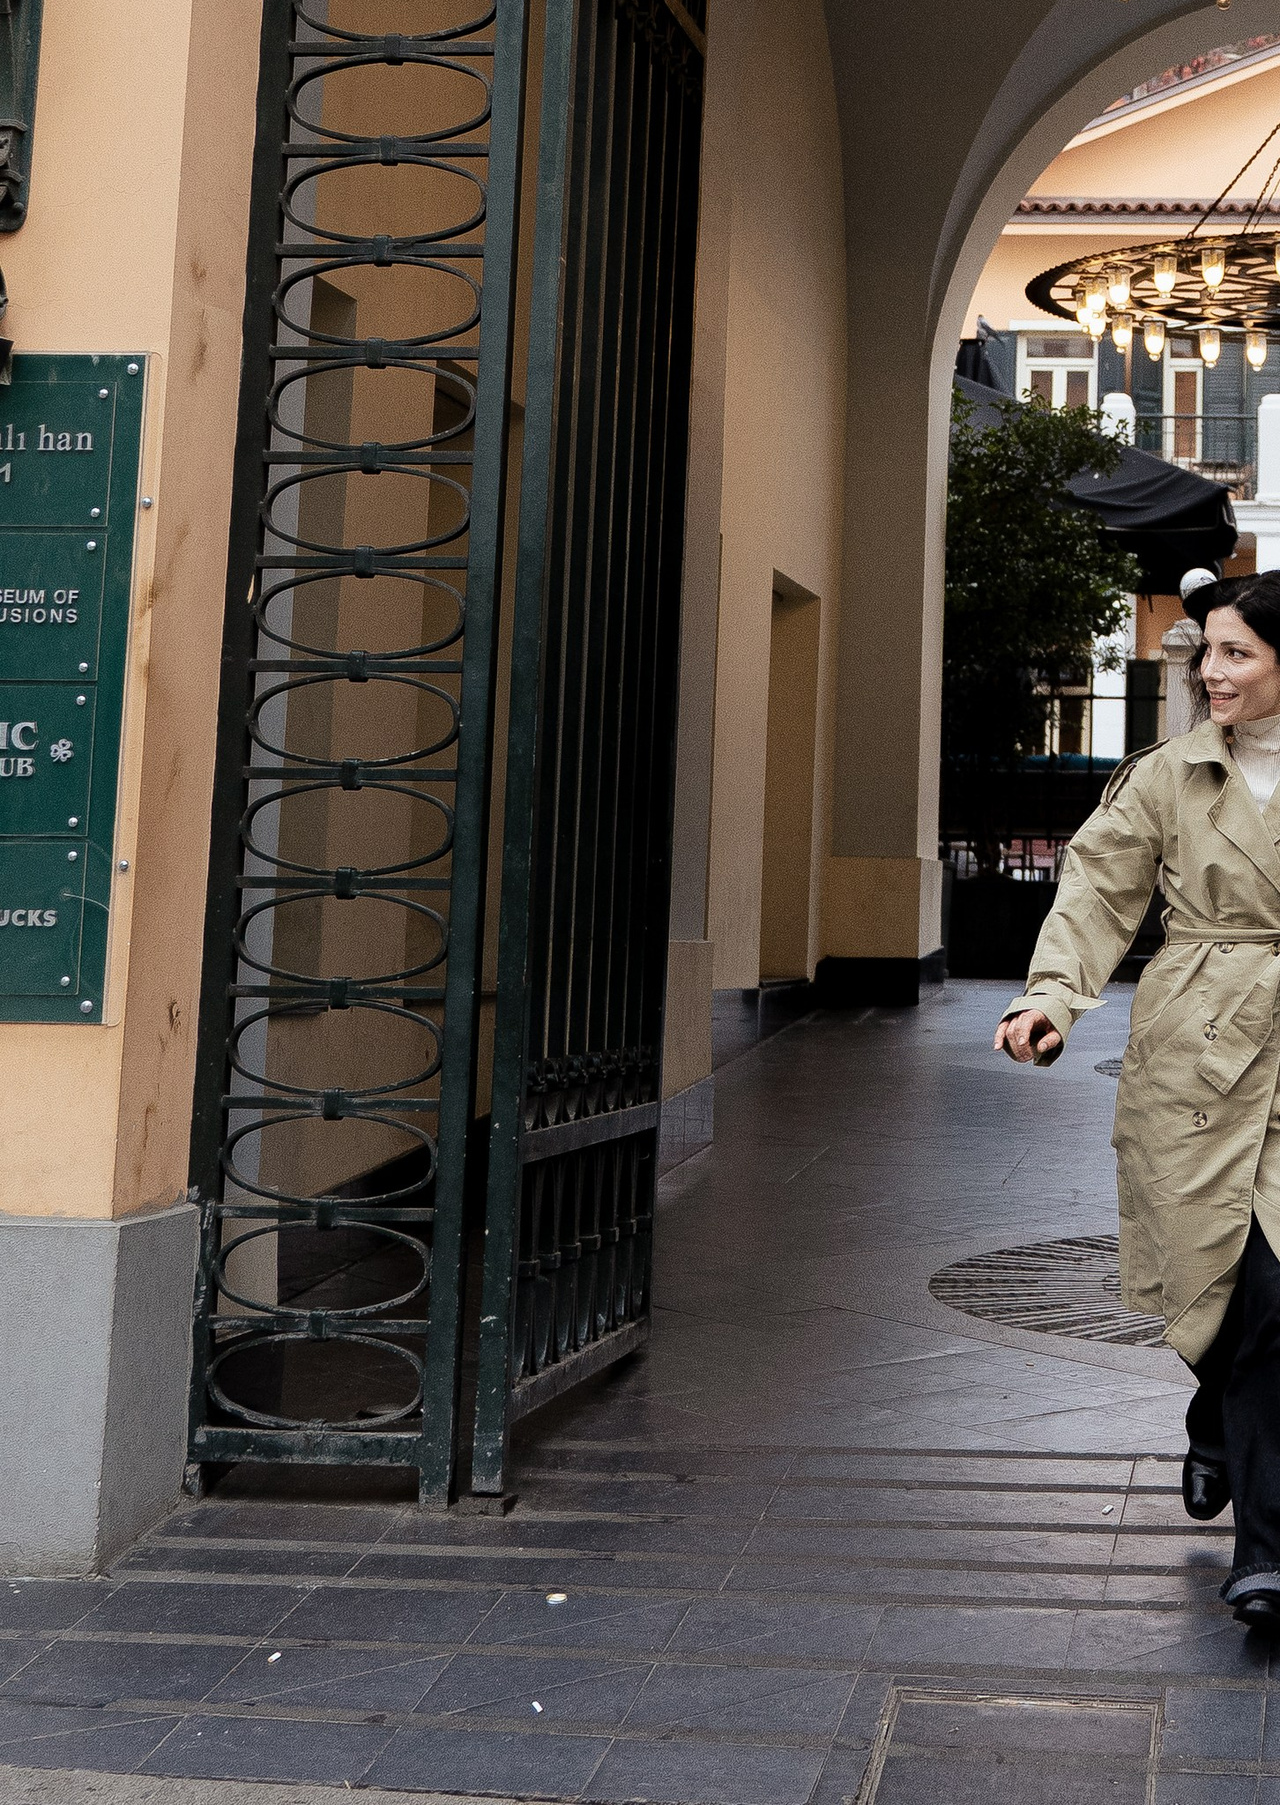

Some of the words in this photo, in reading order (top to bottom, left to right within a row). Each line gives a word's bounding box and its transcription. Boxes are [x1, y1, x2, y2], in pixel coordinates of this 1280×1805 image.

[37, 423, 94, 451] han
[0, 589, 45, 604] EUM
[53, 589, 79, 604] OF
